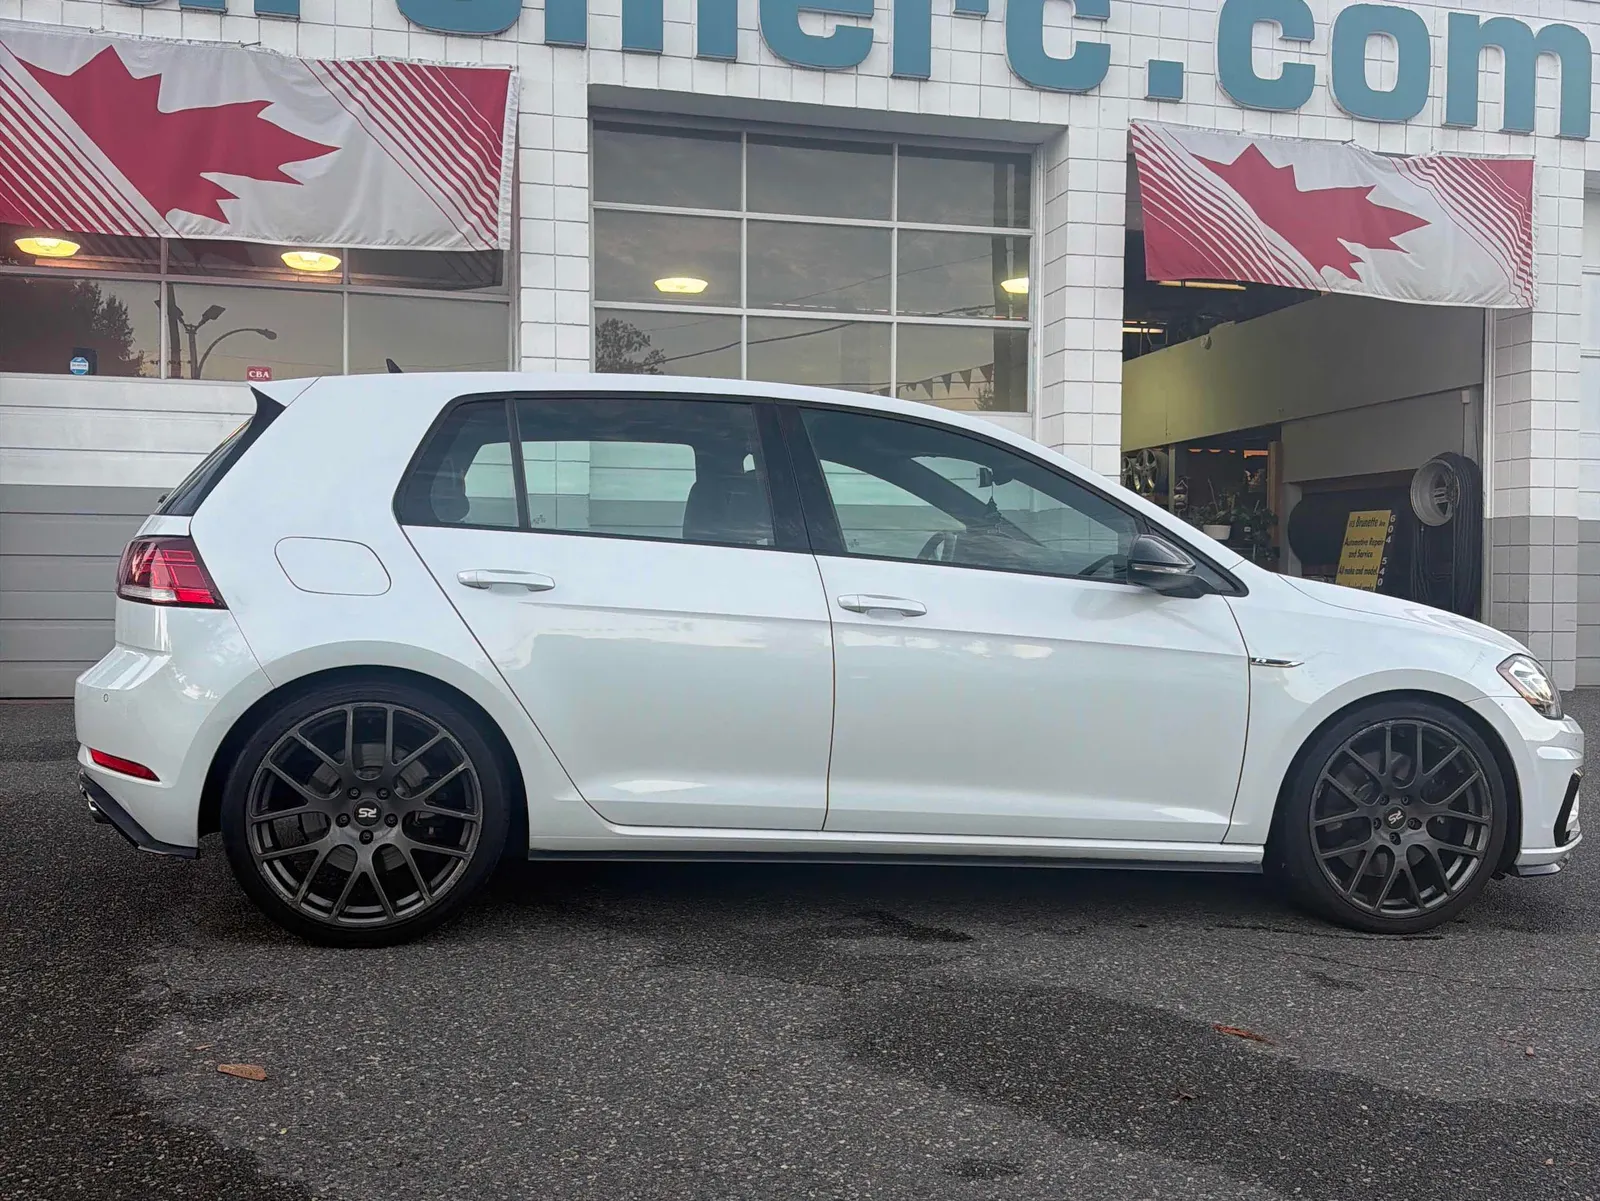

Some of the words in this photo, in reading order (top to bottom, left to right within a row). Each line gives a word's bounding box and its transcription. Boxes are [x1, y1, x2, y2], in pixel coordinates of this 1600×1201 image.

[249, 370, 270, 378] CBA
[1344, 538, 1368, 546] Automotive
[1369, 537, 1384, 548] Repair
[1348, 549, 1356, 558] and
[1356, 549, 1373, 558] Service
